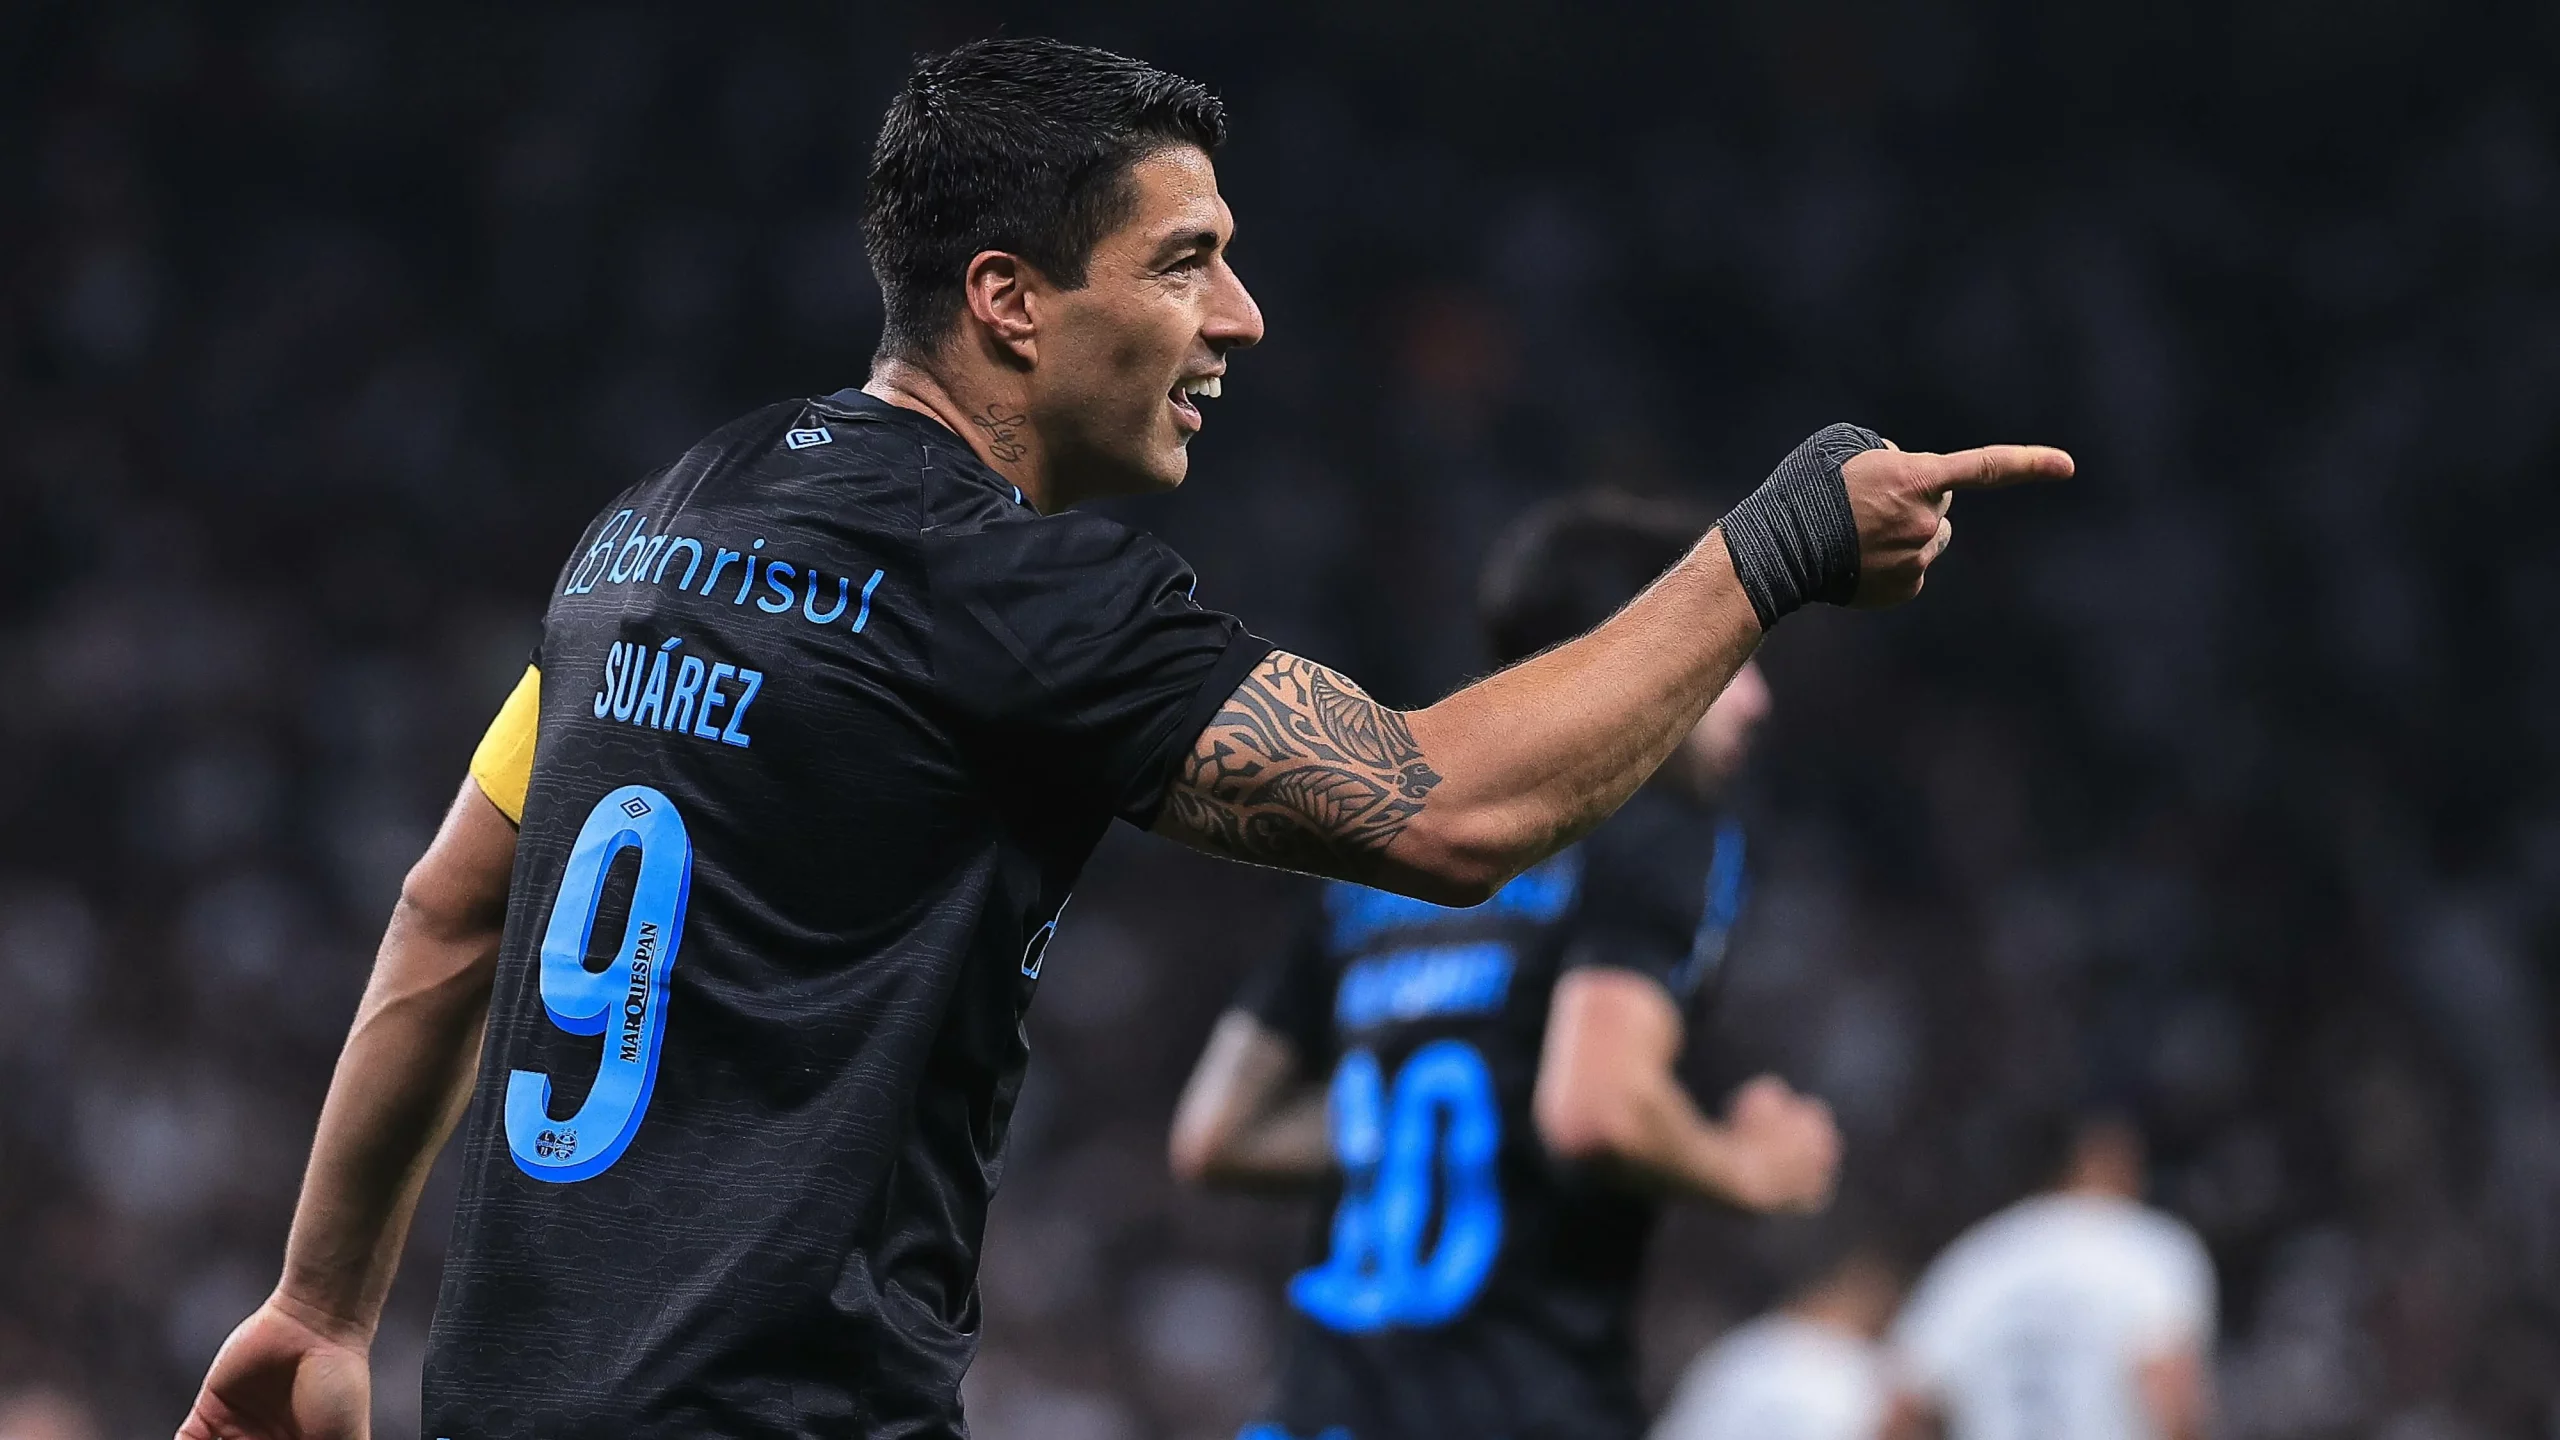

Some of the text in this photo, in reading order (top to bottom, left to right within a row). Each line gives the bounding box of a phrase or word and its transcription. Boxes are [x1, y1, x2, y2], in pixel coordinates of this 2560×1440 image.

[606, 519, 885, 634] banrisul
[594, 637, 764, 748] SUÁREZ
[504, 784, 693, 1184] 9
[619, 921, 658, 1063] MARQUESPAN
